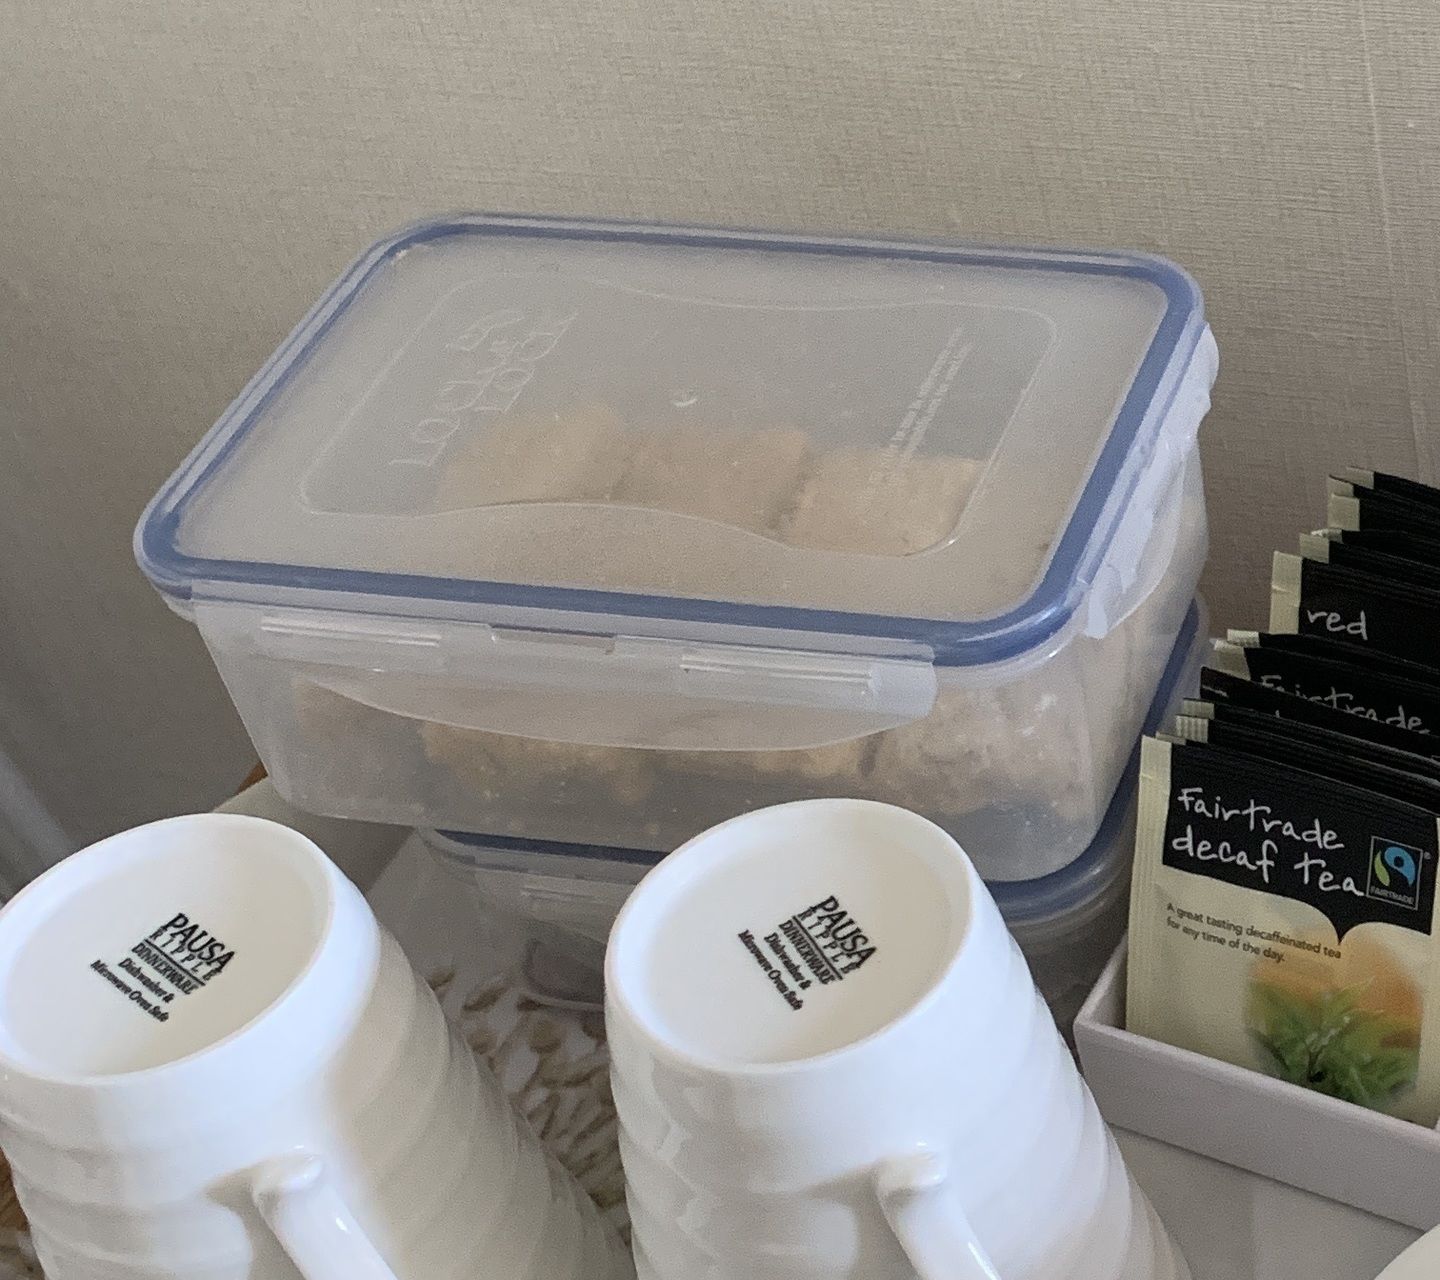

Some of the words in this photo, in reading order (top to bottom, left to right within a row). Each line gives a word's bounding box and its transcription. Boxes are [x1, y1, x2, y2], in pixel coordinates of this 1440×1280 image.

[1307, 609, 1369, 641] red
[1177, 787, 1345, 850] Fairtrade
[1172, 825, 1279, 884] decaf
[1294, 852, 1365, 897] tea
[161, 912, 235, 973] PAUSA
[778, 919, 837, 985] DINNERWARE
[809, 895, 877, 969] PAUSA
[1167, 902, 1175, 913] A
[1176, 906, 1204, 923] great
[1206, 910, 1243, 936] tasting
[1246, 924, 1321, 954] decaffeinated
[1323, 945, 1342, 960] tea
[1167, 916, 1180, 929] for
[1182, 924, 1201, 943] any
[1202, 930, 1227, 948] time
[1228, 937, 1241, 950] of
[1242, 942, 1260, 956] the
[131, 942, 200, 995] DINNERWARE
